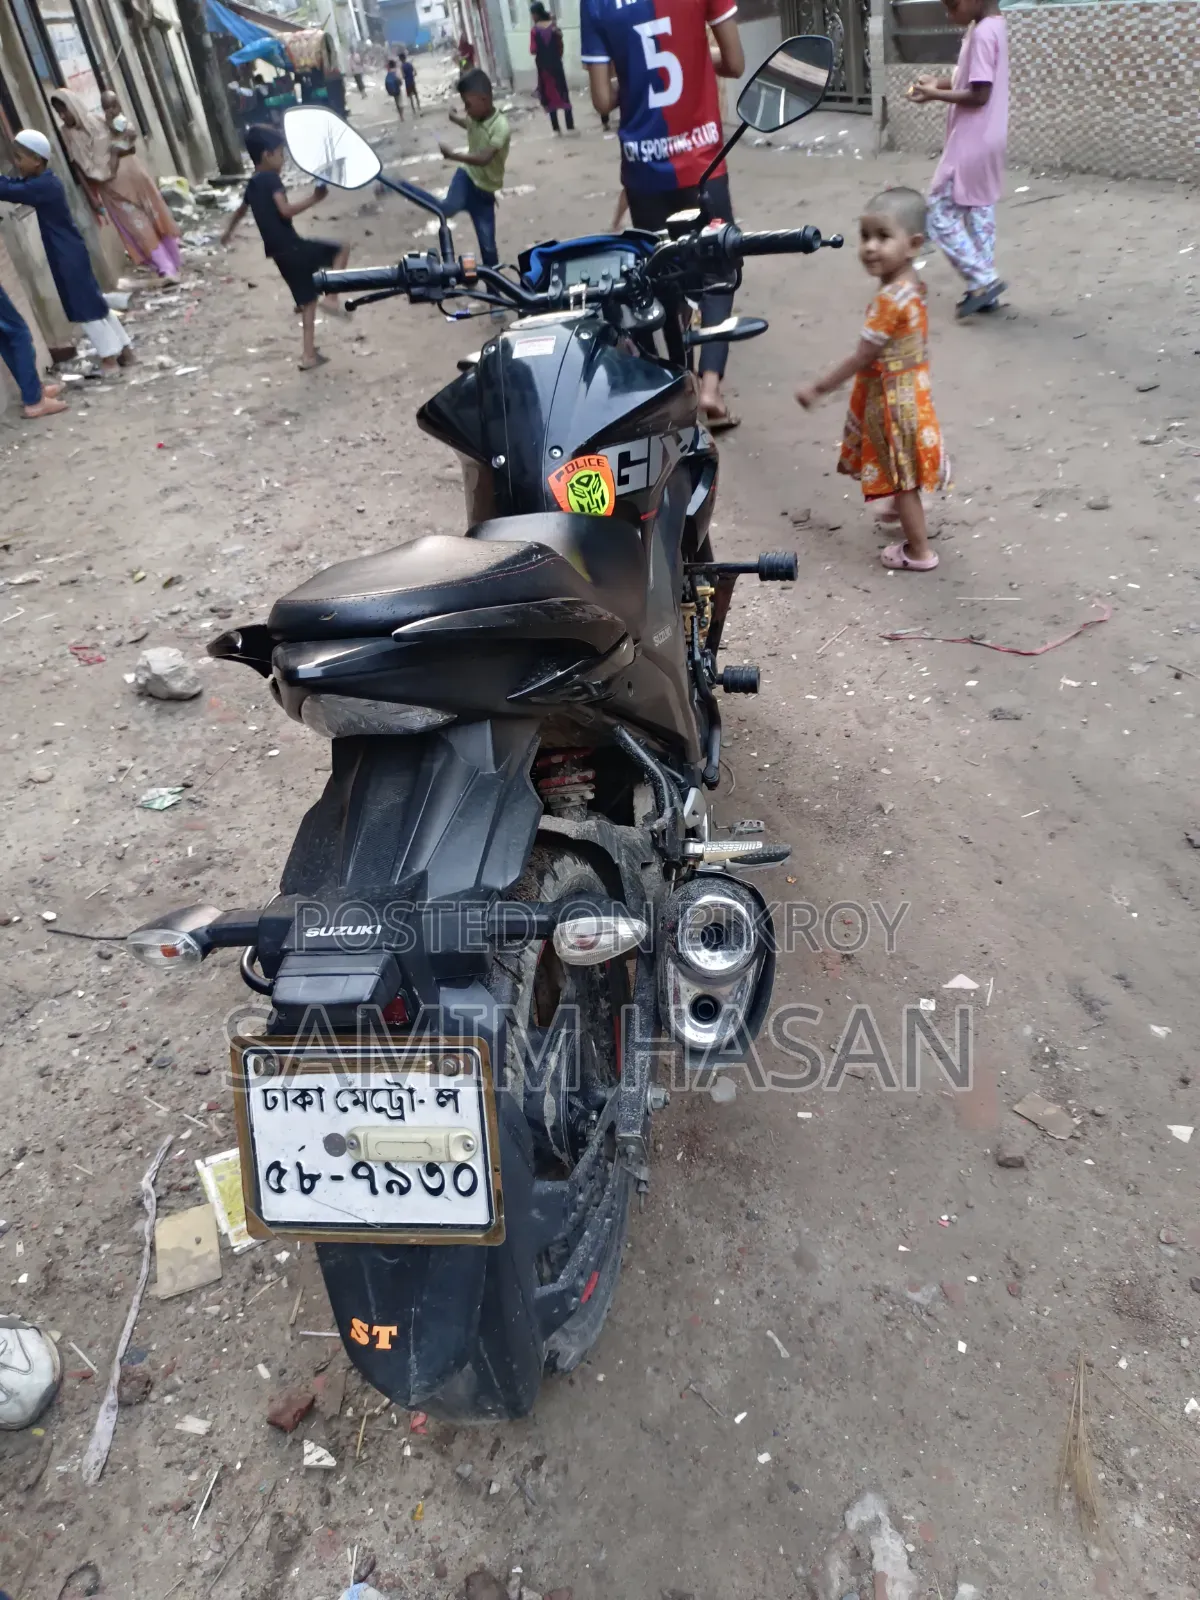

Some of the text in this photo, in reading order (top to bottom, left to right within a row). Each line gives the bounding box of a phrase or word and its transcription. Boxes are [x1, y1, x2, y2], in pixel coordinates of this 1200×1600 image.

[632, 16, 684, 110] 5
[640, 131, 693, 163] SPORTING
[691, 121, 720, 149] CLUB
[554, 457, 605, 483] POLICE
[305, 924, 382, 938] SUZUKI
[262, 1086, 325, 1113] ঢাকা
[265, 1160, 479, 1198] ৫৮-৭৯৩০
[350, 1317, 398, 1350] ST
